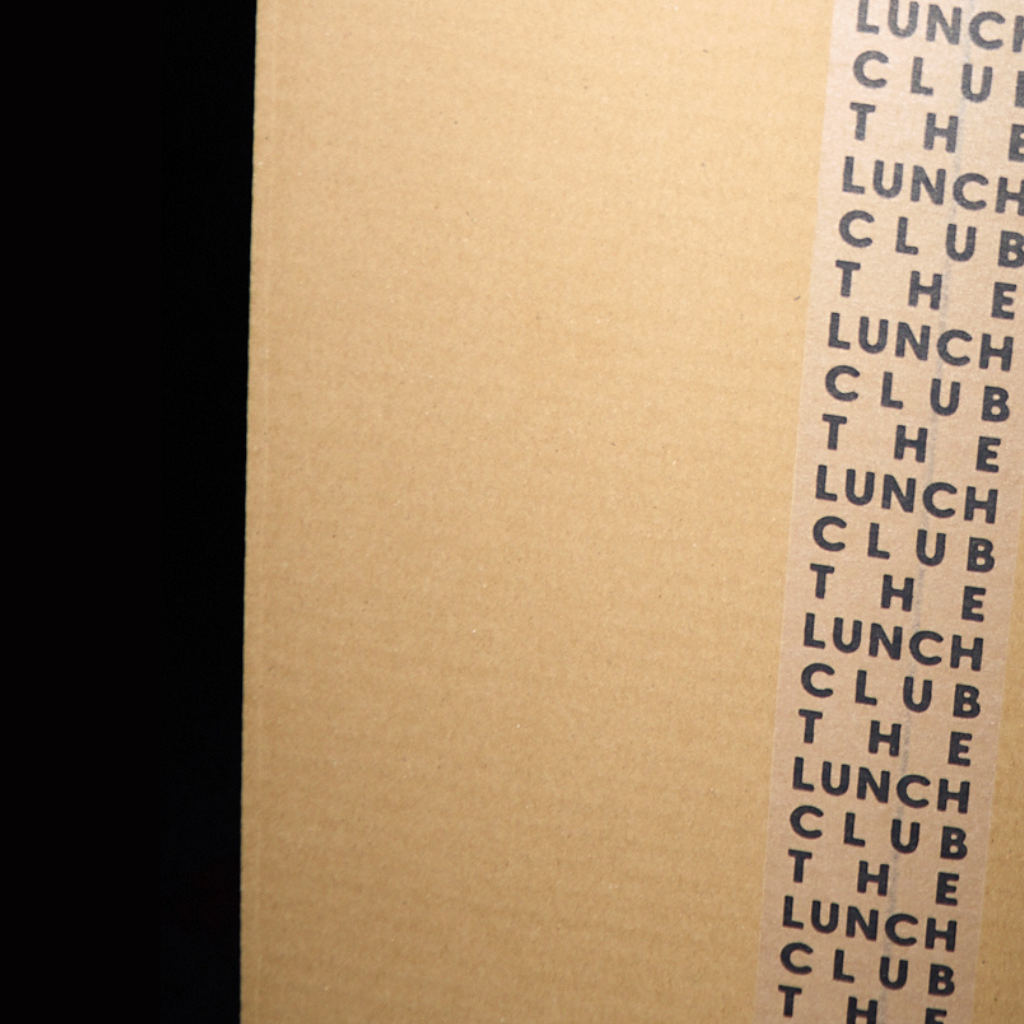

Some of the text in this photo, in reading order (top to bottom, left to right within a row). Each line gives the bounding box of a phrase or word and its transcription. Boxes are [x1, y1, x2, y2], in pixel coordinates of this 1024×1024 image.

[834, 258, 1018, 321] THE
[827, 311, 1015, 373] LUNCH
[824, 364, 1011, 423] CLUB
[821, 412, 1002, 474] THE
[814, 463, 999, 525] LUNCH
[812, 515, 996, 574] CLUB
[809, 562, 987, 623] THE
[802, 612, 985, 672] LUNCH
[800, 662, 981, 719] CLUB
[797, 708, 973, 768] THE
[792, 756, 971, 815] LUNCH
[789, 804, 968, 861] CLUB
[787, 848, 960, 907] THE
[782, 894, 958, 953] LUNCH
[779, 941, 956, 997] CLUB
